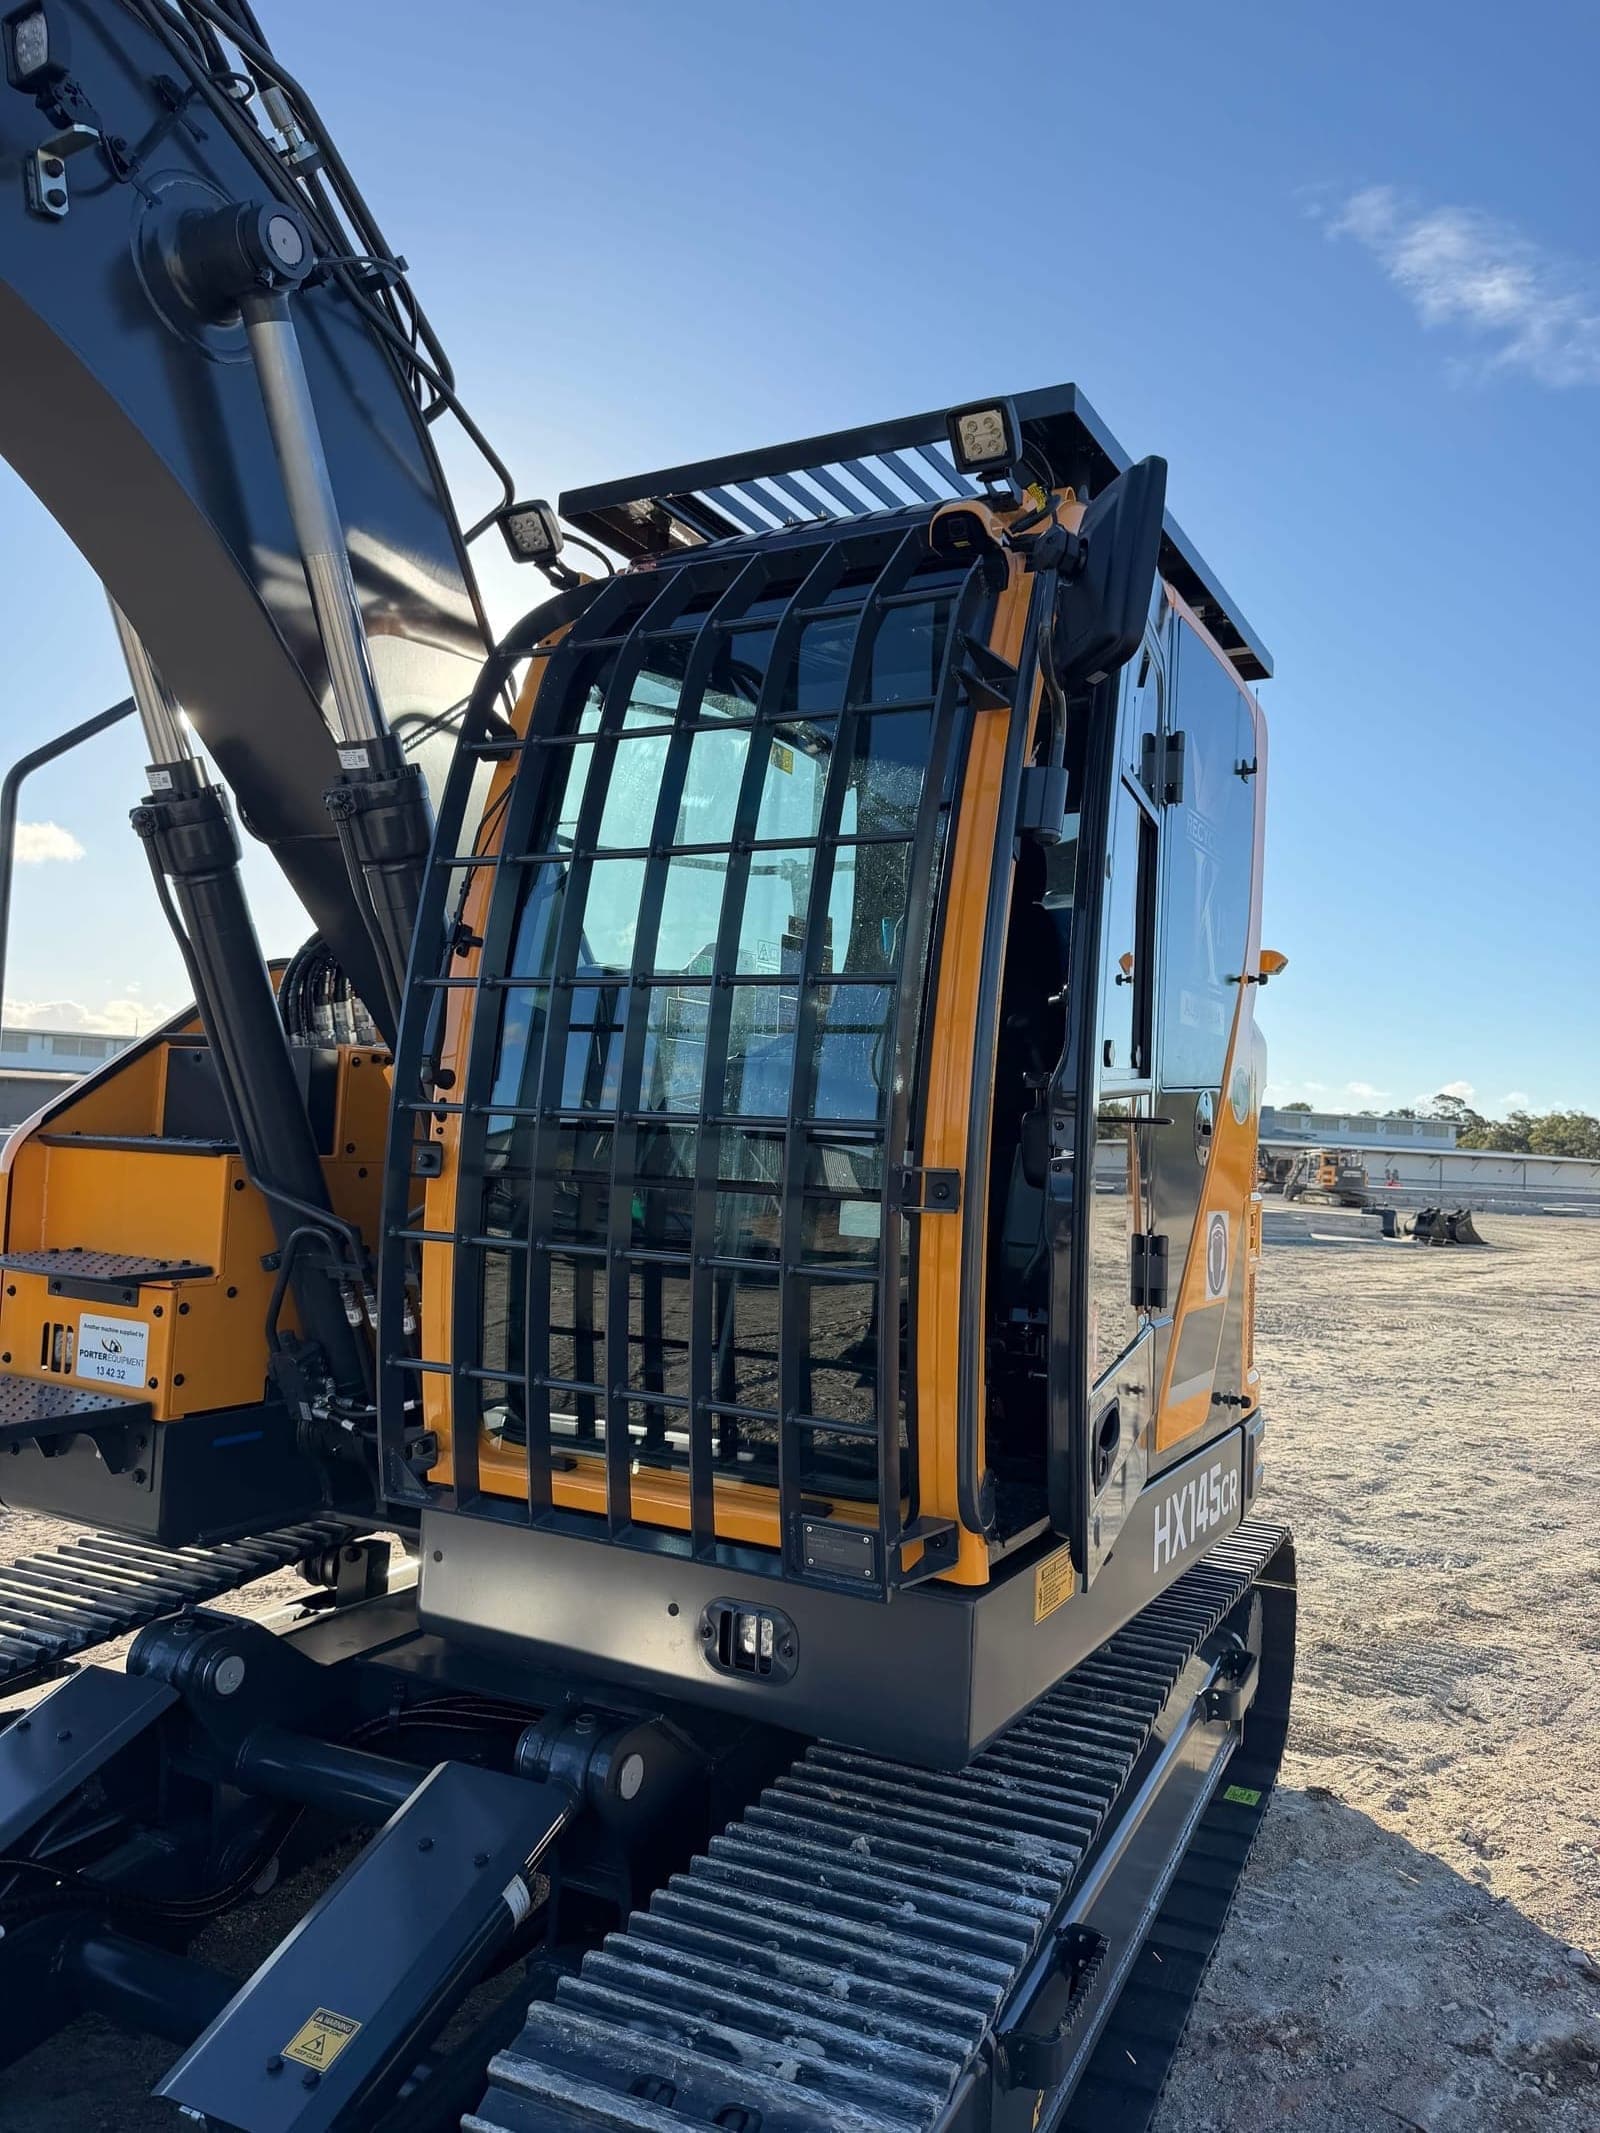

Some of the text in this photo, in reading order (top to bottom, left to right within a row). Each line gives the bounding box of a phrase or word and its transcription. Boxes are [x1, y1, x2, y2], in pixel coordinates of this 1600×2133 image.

[96, 1366, 126, 1380] 13 42 32
[1153, 1462, 1238, 1575] HX145CR
[322, 2014, 354, 2033] WARNING
